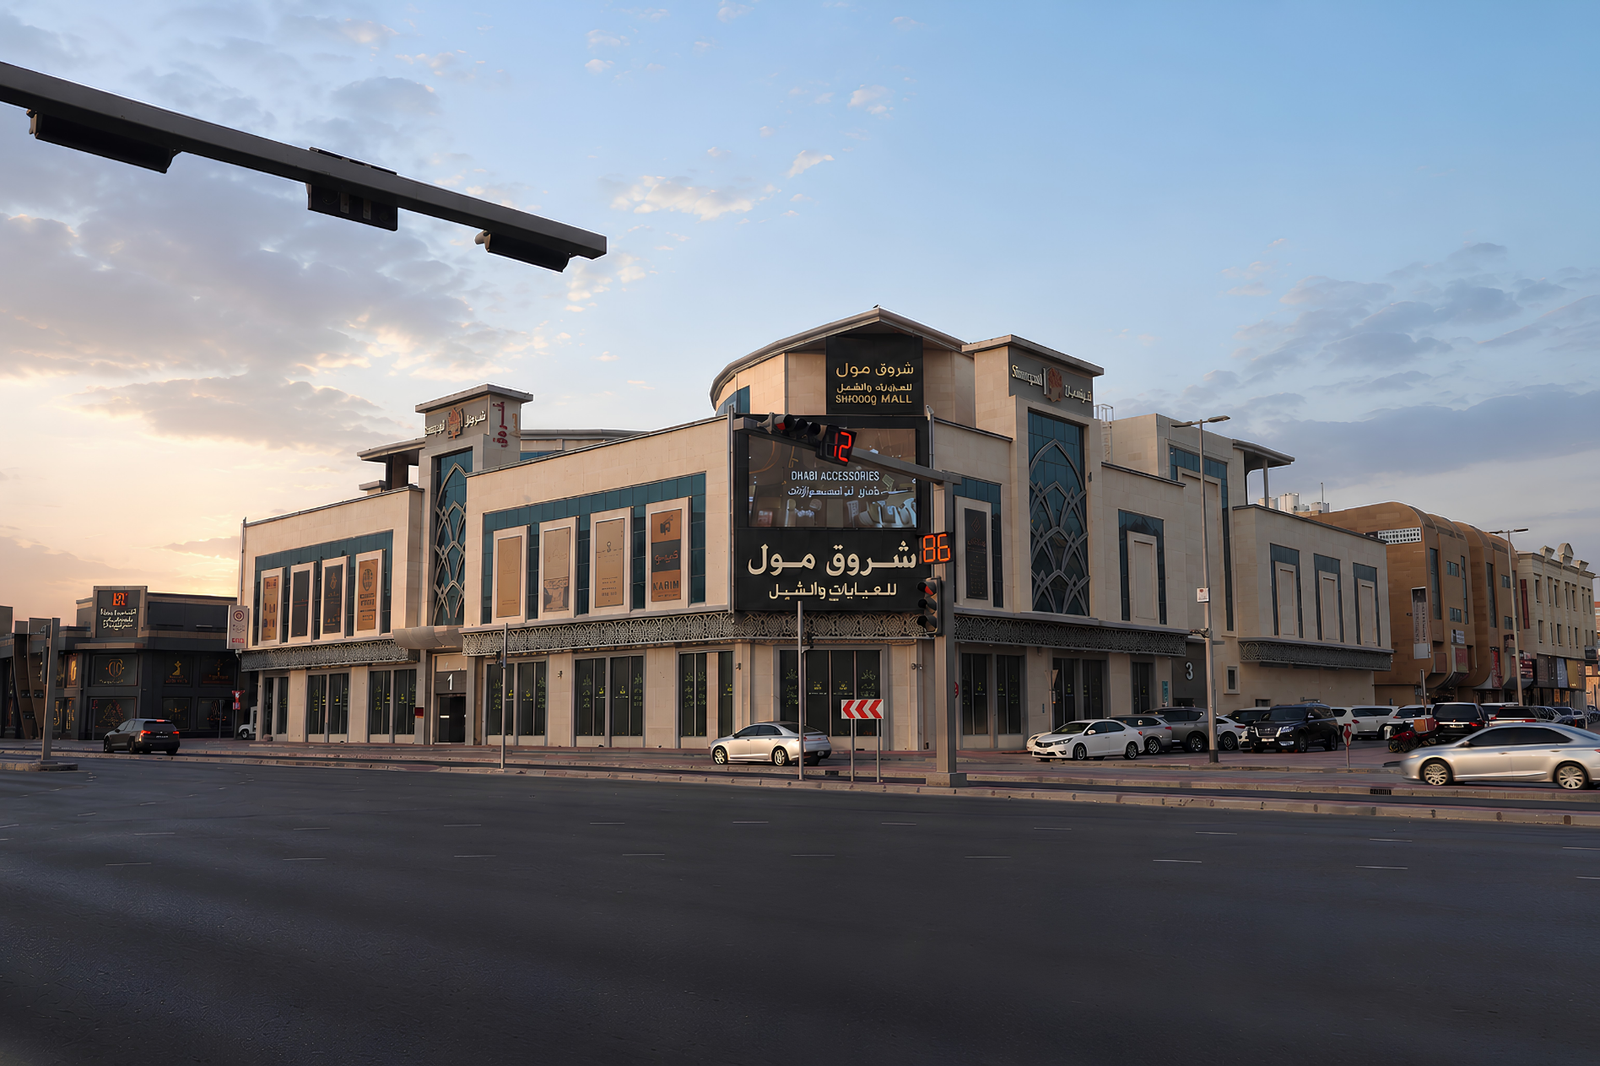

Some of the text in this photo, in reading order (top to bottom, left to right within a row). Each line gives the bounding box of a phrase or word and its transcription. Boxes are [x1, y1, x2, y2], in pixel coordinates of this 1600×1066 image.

[835, 361, 914, 378] شروق مول
[881, 394, 913, 404] MALL
[833, 431, 852, 463] 12
[820, 470, 880, 481] ACCESSORIES
[922, 533, 951, 563] 86
[747, 540, 917, 577] شروق مول
[1185, 661, 1194, 680] 3
[446, 673, 453, 691] 1
